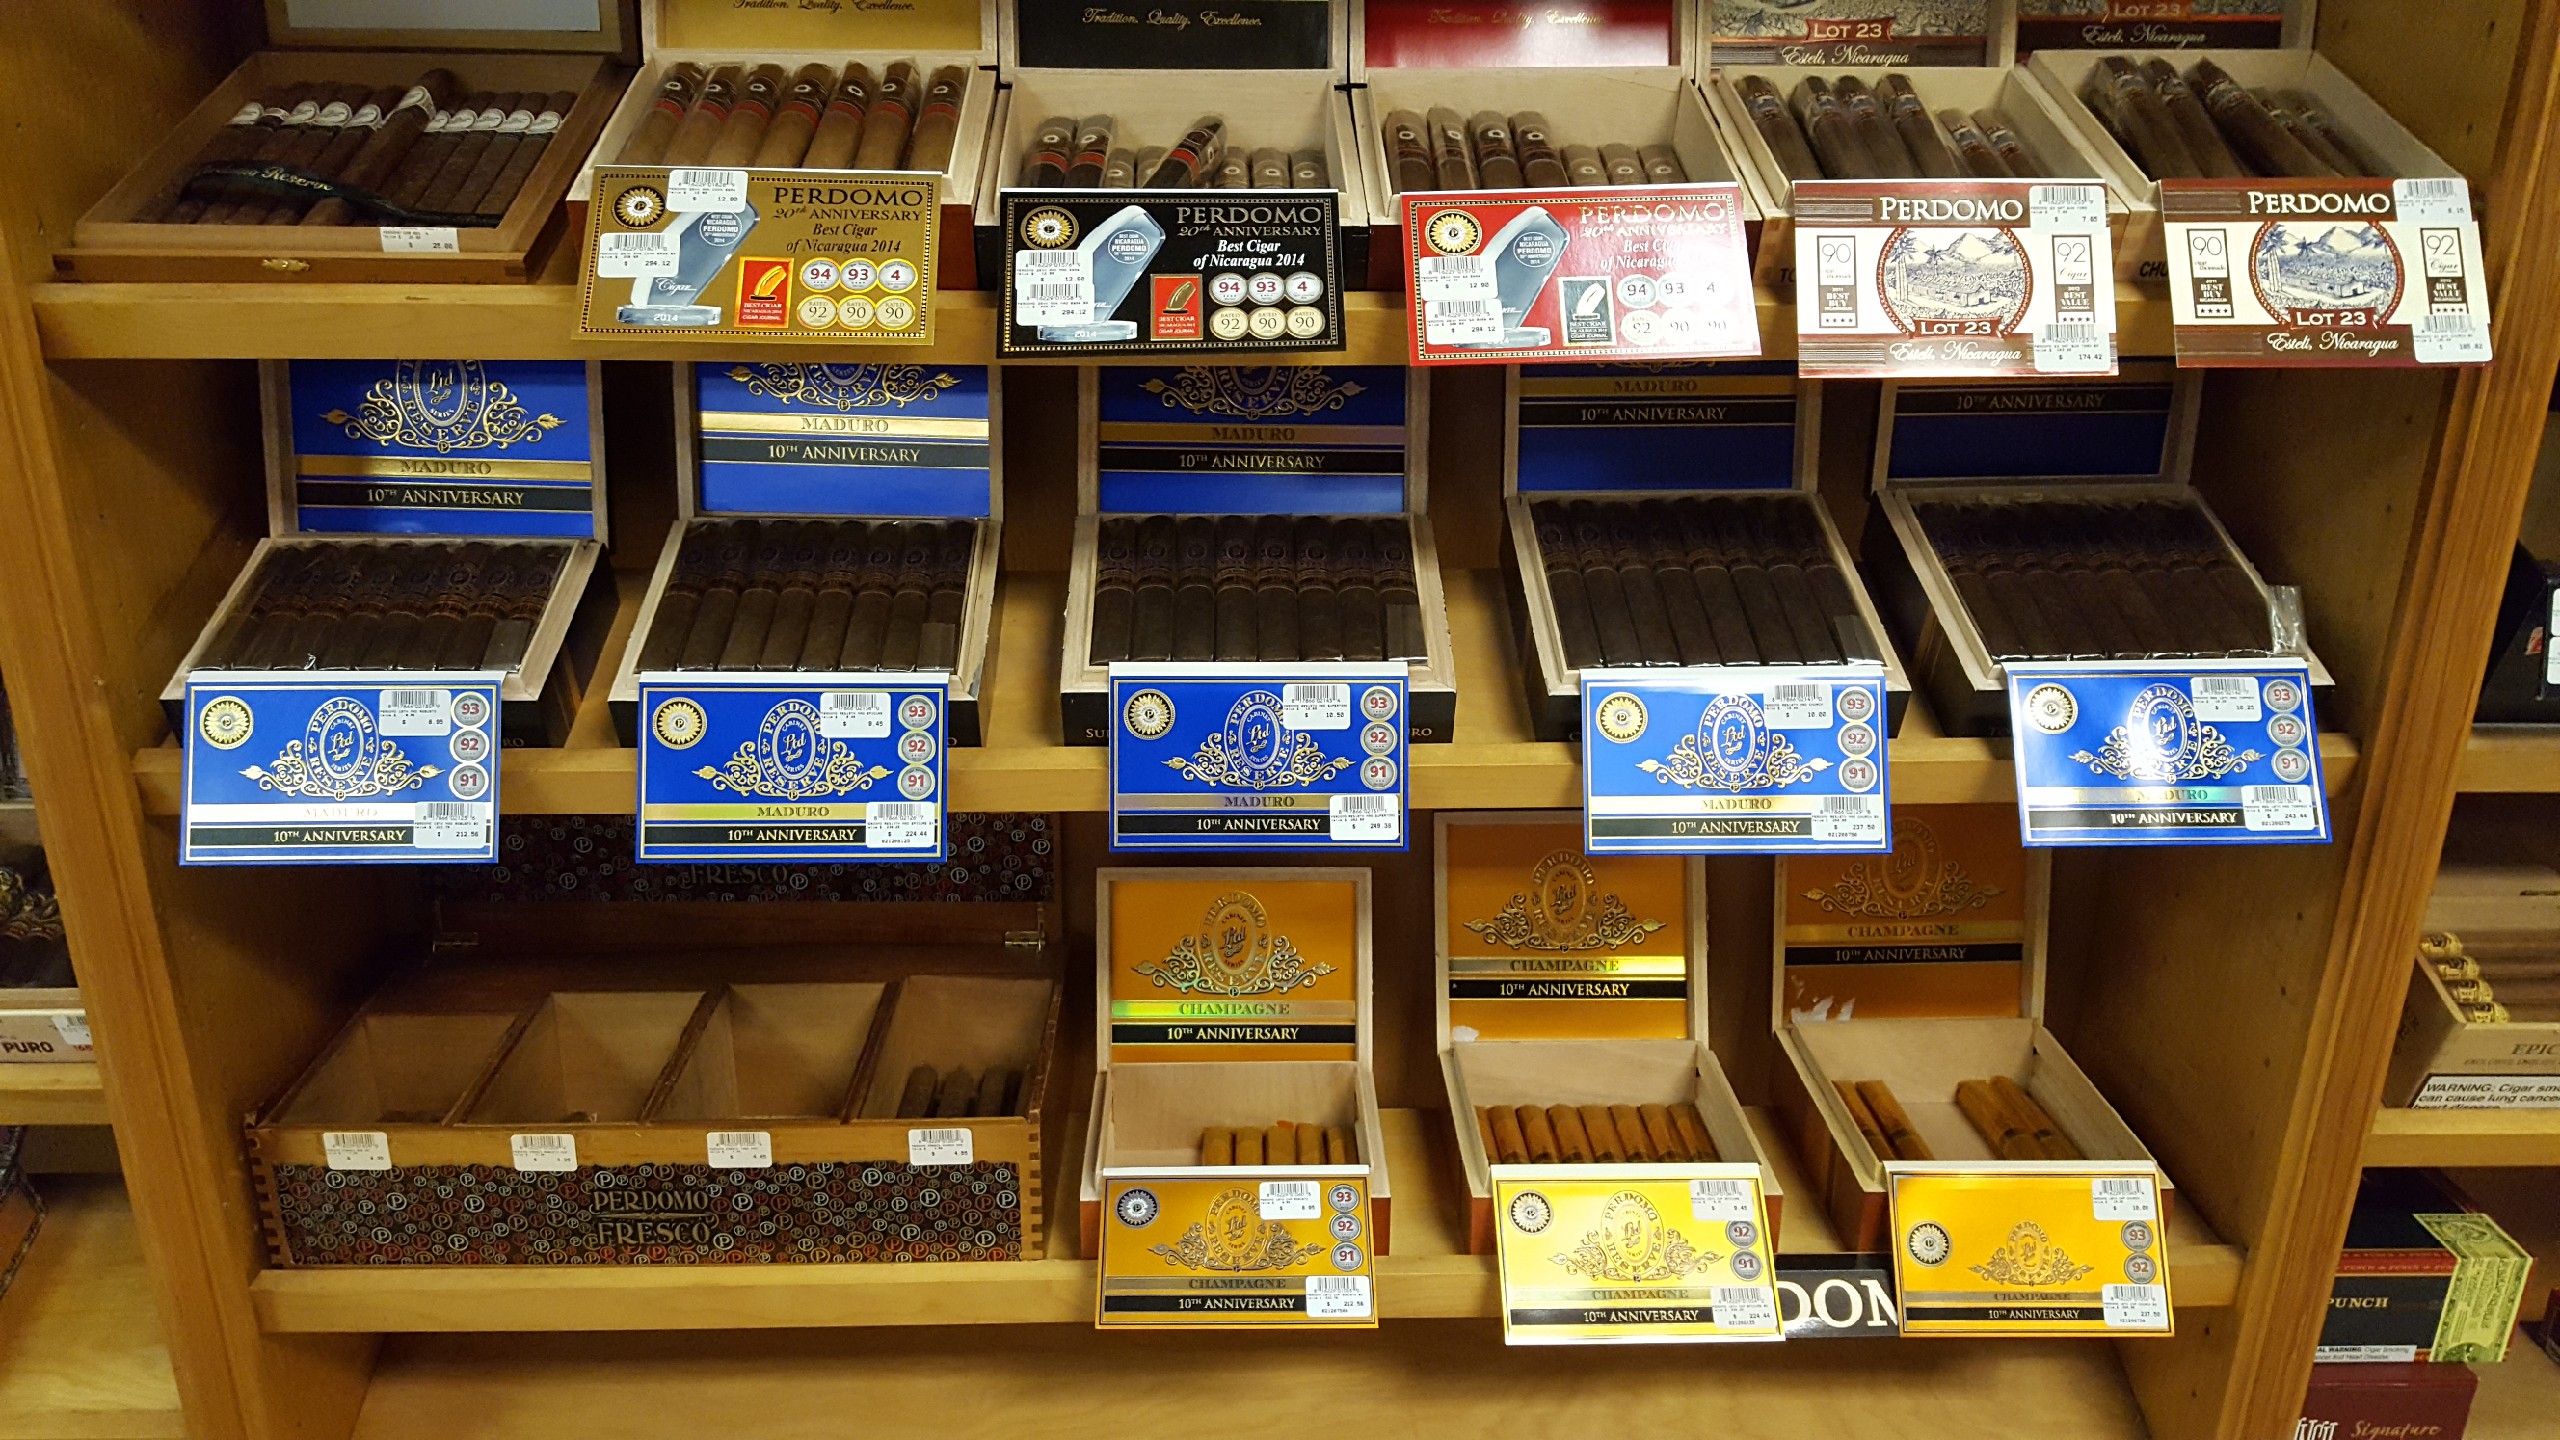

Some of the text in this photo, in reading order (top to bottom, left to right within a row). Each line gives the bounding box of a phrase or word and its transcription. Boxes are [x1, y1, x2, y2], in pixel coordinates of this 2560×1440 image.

[2115, 4, 2180, 16] LOT 23
[1082, 7, 1262, 31] Tradition. Quality. Excellence.
[1814, 24, 1882, 38] LOT 23
[1832, 44, 1909, 67] Nicaragua
[773, 187, 923, 206] PERDOMO
[2247, 191, 2390, 214] PERDOMO
[810, 209, 922, 221] ANNIVERSARY
[1578, 203, 1725, 225] PERDOMO
[1880, 196, 2024, 221] PERDOMO
[1176, 207, 1322, 224] PERDOMO
[813, 224, 877, 238] Best Cigar
[1213, 227, 1321, 236] ANNIVERSARY
[787, 239, 901, 254] of Nicaragua 2014
[1217, 239, 1281, 254] Best Cigar
[1624, 240, 1649, 253] Best
[2193, 237, 2222, 255] 90
[2426, 235, 2456, 255] 92
[1822, 244, 1851, 263] 90
[2057, 243, 2086, 263] 92
[1193, 254, 1305, 269] of Nicaragua 2014
[1601, 256, 1614, 271] of
[810, 268, 900, 281] 94 93 4
[1219, 281, 1307, 293] 94 93 4
[1627, 281, 1715, 296] 94 93 4
[2064, 291, 2086, 299] BEST
[653, 313, 679, 322] 2014
[809, 307, 904, 318] 92 90 90
[2296, 312, 2366, 325] LOT 23
[1221, 317, 1314, 330] 92 90 90
[1921, 322, 1991, 335] LOT 23
[2319, 331, 2399, 356] Nicaragua
[1942, 341, 2022, 366] Nicaragua
[1614, 380, 1697, 393] MADURO
[1989, 394, 2104, 409] ANNIVERSARY
[1581, 407, 1727, 421] 10TH ANNIVERSARY
[801, 417, 889, 432] MADURO
[1211, 427, 1295, 441] MADURO
[768, 445, 921, 462] 10TH ANNIVERSARY
[400, 459, 492, 475] MADURO
[1180, 454, 1325, 469] 10TH ANNIVERSARY
[367, 489, 524, 505] 10TH ANNIVERSARY
[2274, 689, 2291, 701] 93
[461, 703, 479, 715] 93
[1370, 697, 1388, 709] 93
[1846, 699, 1865, 710] 93
[908, 706, 926, 717] 93
[1703, 695, 1763, 728] PERDOMO
[2278, 723, 2296, 735] 92
[1370, 732, 1387, 743] 92
[1848, 733, 1866, 744] 92
[460, 738, 479, 751] 92
[908, 740, 926, 753] 92
[1705, 749, 1765, 782] RESERVE
[2281, 758, 2299, 769] 91
[1370, 765, 1387, 777] 91
[1848, 768, 1866, 779] 91
[460, 774, 477, 787] 91
[908, 775, 924, 787] 91
[1224, 796, 1295, 807] MADURO
[1701, 798, 1772, 810] MADURO
[757, 806, 830, 817] MADURO
[2138, 811, 2238, 824] ANNIVERSARY
[1197, 818, 1321, 831] 10TH ANNIVERSARY
[1671, 820, 1801, 834] 10TH ANNIVERSARY
[274, 829, 406, 842] 10TH ANNIVERSARY
[728, 829, 857, 841] 10TH ANNIVERSARY
[691, 864, 788, 884] FRESCO
[1848, 924, 1959, 938] CHAMPAGNE
[1864, 948, 1967, 961] ANNIVERSARY
[1510, 960, 1619, 972] CHAMPAGNE
[1500, 983, 1629, 996] 10TH ANNIVERSARY
[1179, 1003, 1290, 1015] CHAMPAGNE
[1167, 1027, 1299, 1040] 10TH ANNIVERSARY
[2, 1042, 54, 1053] PURO
[2426, 1084, 2533, 1093] WARNING: Cigar
[2488, 1095, 2517, 1103] lung
[593, 1191, 708, 1210] PERDOMO
[1336, 1191, 1352, 1202] 93
[1605, 1193, 1658, 1221] PERDOMO
[1338, 1221, 1354, 1231] 92
[1734, 1226, 1751, 1237] 92
[598, 1222, 710, 1244] FRESCO
[2130, 1229, 2146, 1241] 93
[1339, 1251, 1355, 1261] 91
[1738, 1259, 1754, 1269] 91
[2132, 1263, 2148, 1273] 92
[1189, 1279, 1286, 1289] CHAMPAGNE
[1593, 1289, 1688, 1300] CHAMPAGNE
[1179, 1298, 1295, 1309] 10TH ANNIVERSARY
[1584, 1310, 1698, 1322] 10TH ANNIVERSARY
[2010, 1310, 2079, 1320] ANNIVERSARY
[2352, 1420, 2441, 1440] Signature
